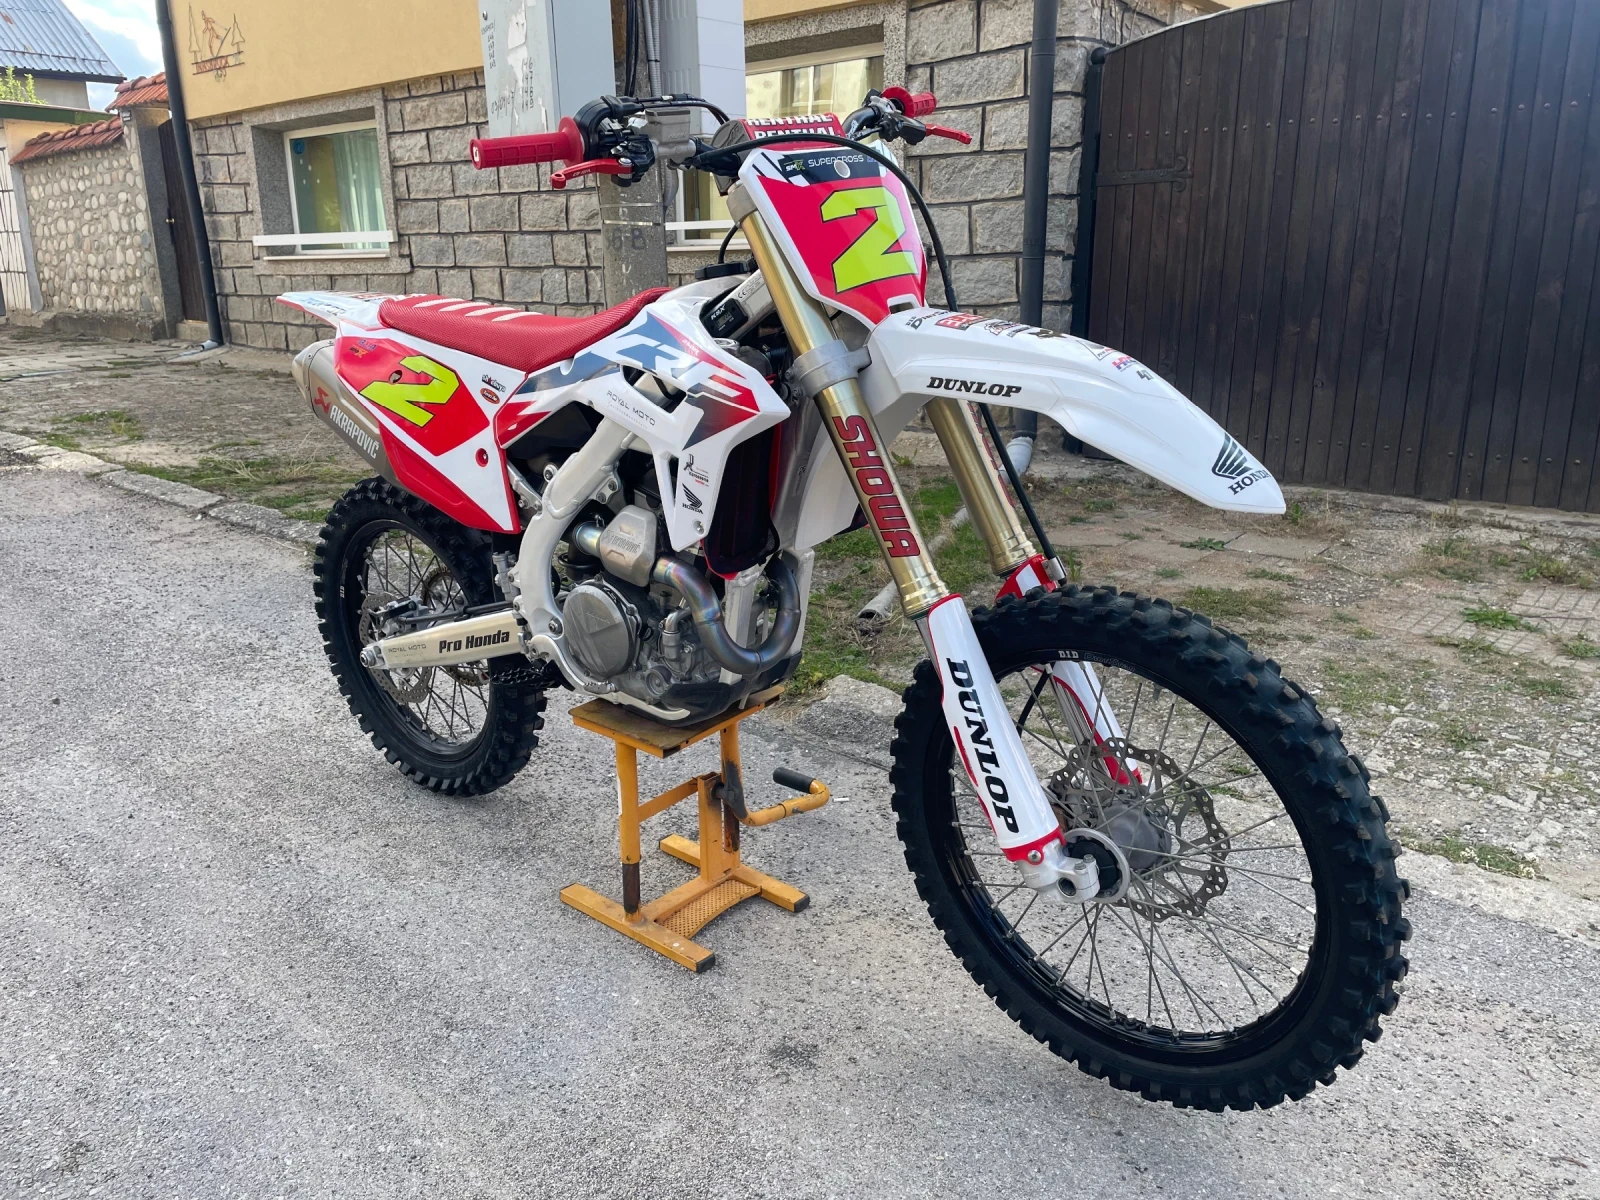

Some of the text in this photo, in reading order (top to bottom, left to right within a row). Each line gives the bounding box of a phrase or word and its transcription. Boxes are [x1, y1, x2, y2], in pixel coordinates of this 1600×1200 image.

[820, 186, 919, 294] 2
[358, 355, 460, 428] 2
[926, 376, 1022, 398] DUNLOP
[606, 390, 630, 410] ROYAL
[632, 407, 656, 426] MOTO
[832, 415, 920, 558] SHOWA
[1228, 470, 1271, 496] HONDA
[682, 503, 704, 514] HONDA
[439, 630, 510, 654] Pro Honda
[946, 657, 1020, 834] DUNLOP
